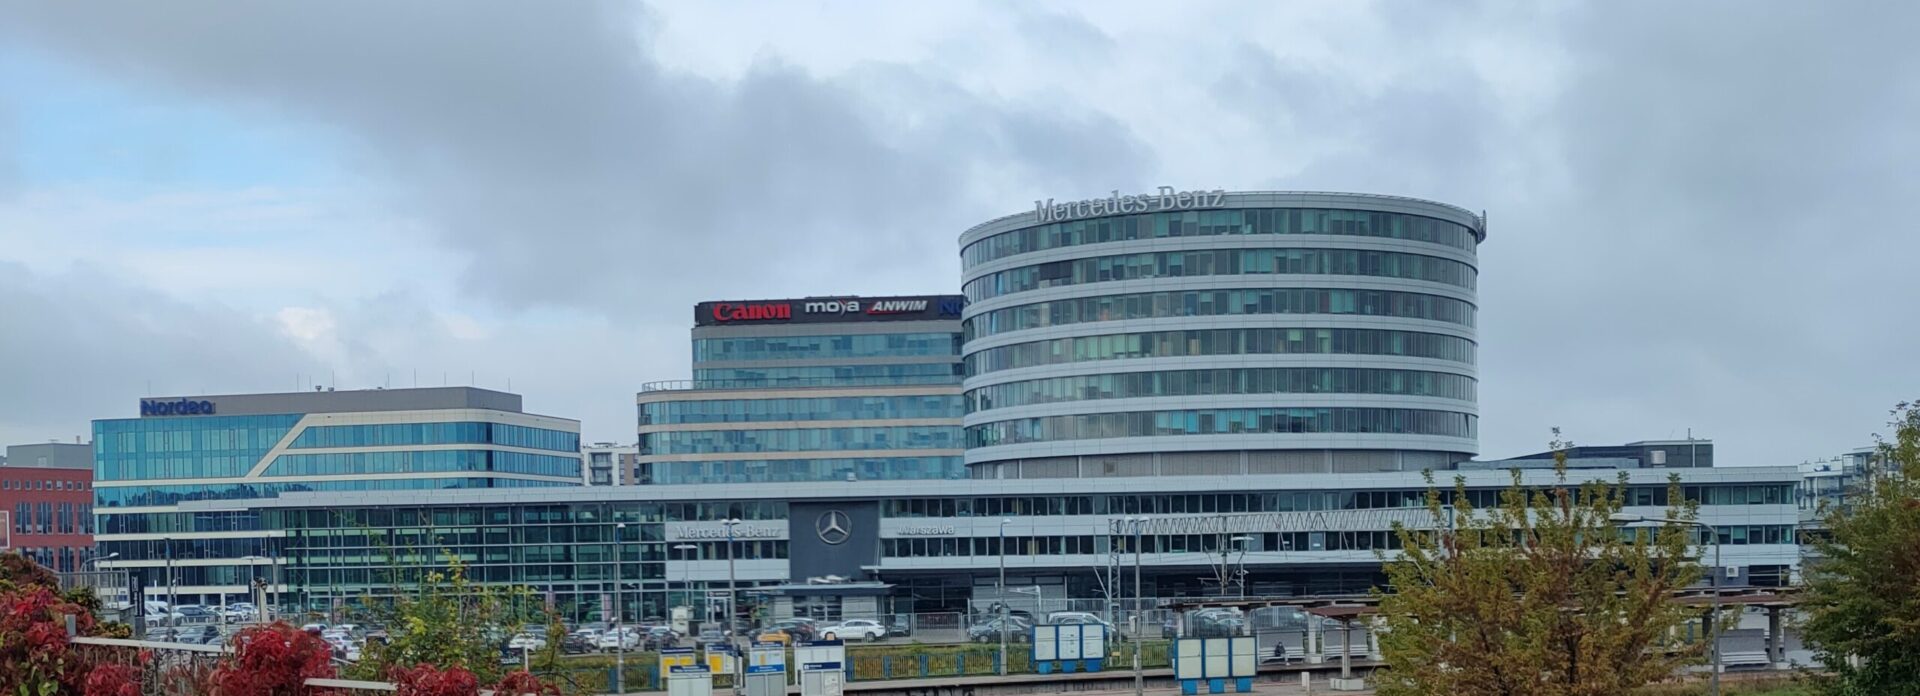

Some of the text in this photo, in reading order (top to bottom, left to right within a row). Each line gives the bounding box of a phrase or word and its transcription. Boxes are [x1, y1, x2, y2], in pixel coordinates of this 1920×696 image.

[1034, 186, 1225, 223] Mercedes-Benz
[713, 303, 791, 321] Canon
[805, 300, 859, 316] moya
[871, 300, 929, 312] ANWIM
[140, 397, 216, 416] Nordea
[897, 526, 955, 536] Warszawa
